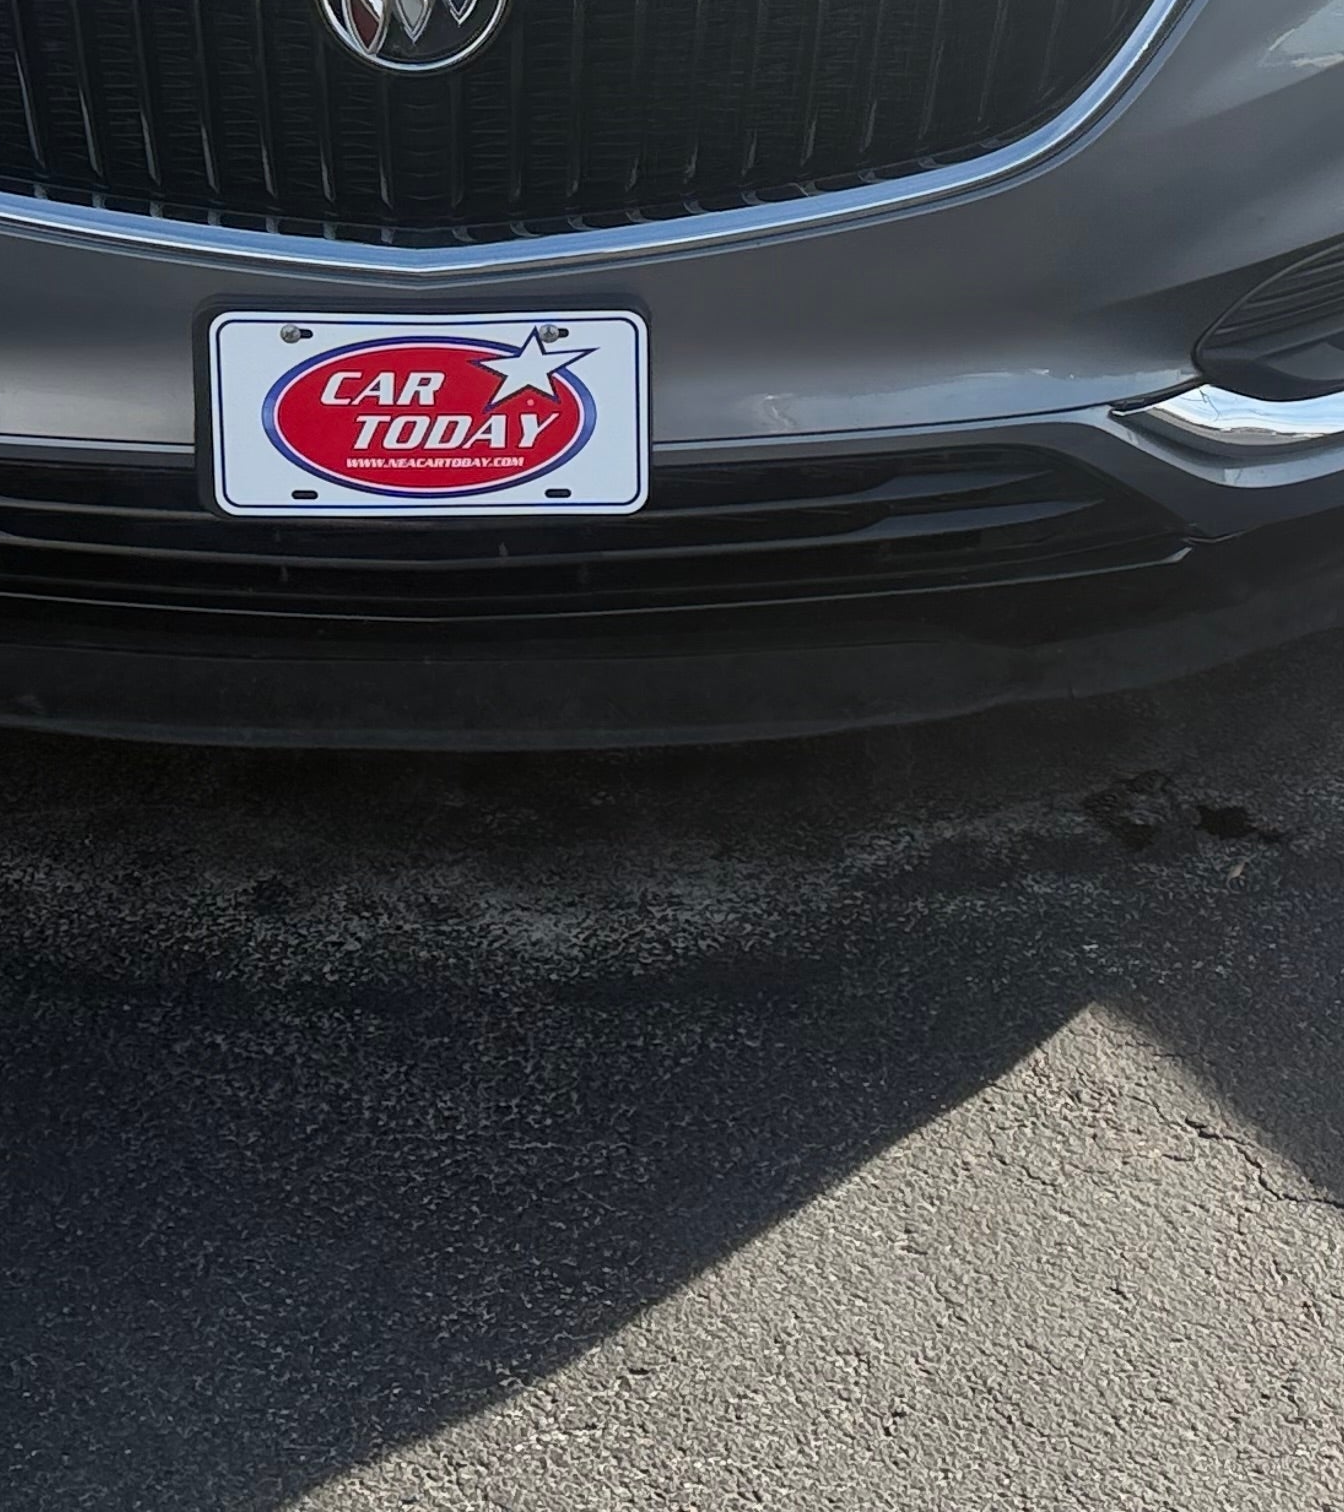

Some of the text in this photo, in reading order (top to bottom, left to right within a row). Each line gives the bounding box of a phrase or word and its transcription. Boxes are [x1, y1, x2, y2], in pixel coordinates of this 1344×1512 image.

[319, 370, 447, 407] CAR
[352, 412, 561, 451] TODAY
[346, 457, 525, 469] WWW.NEACARTODAY.COM
